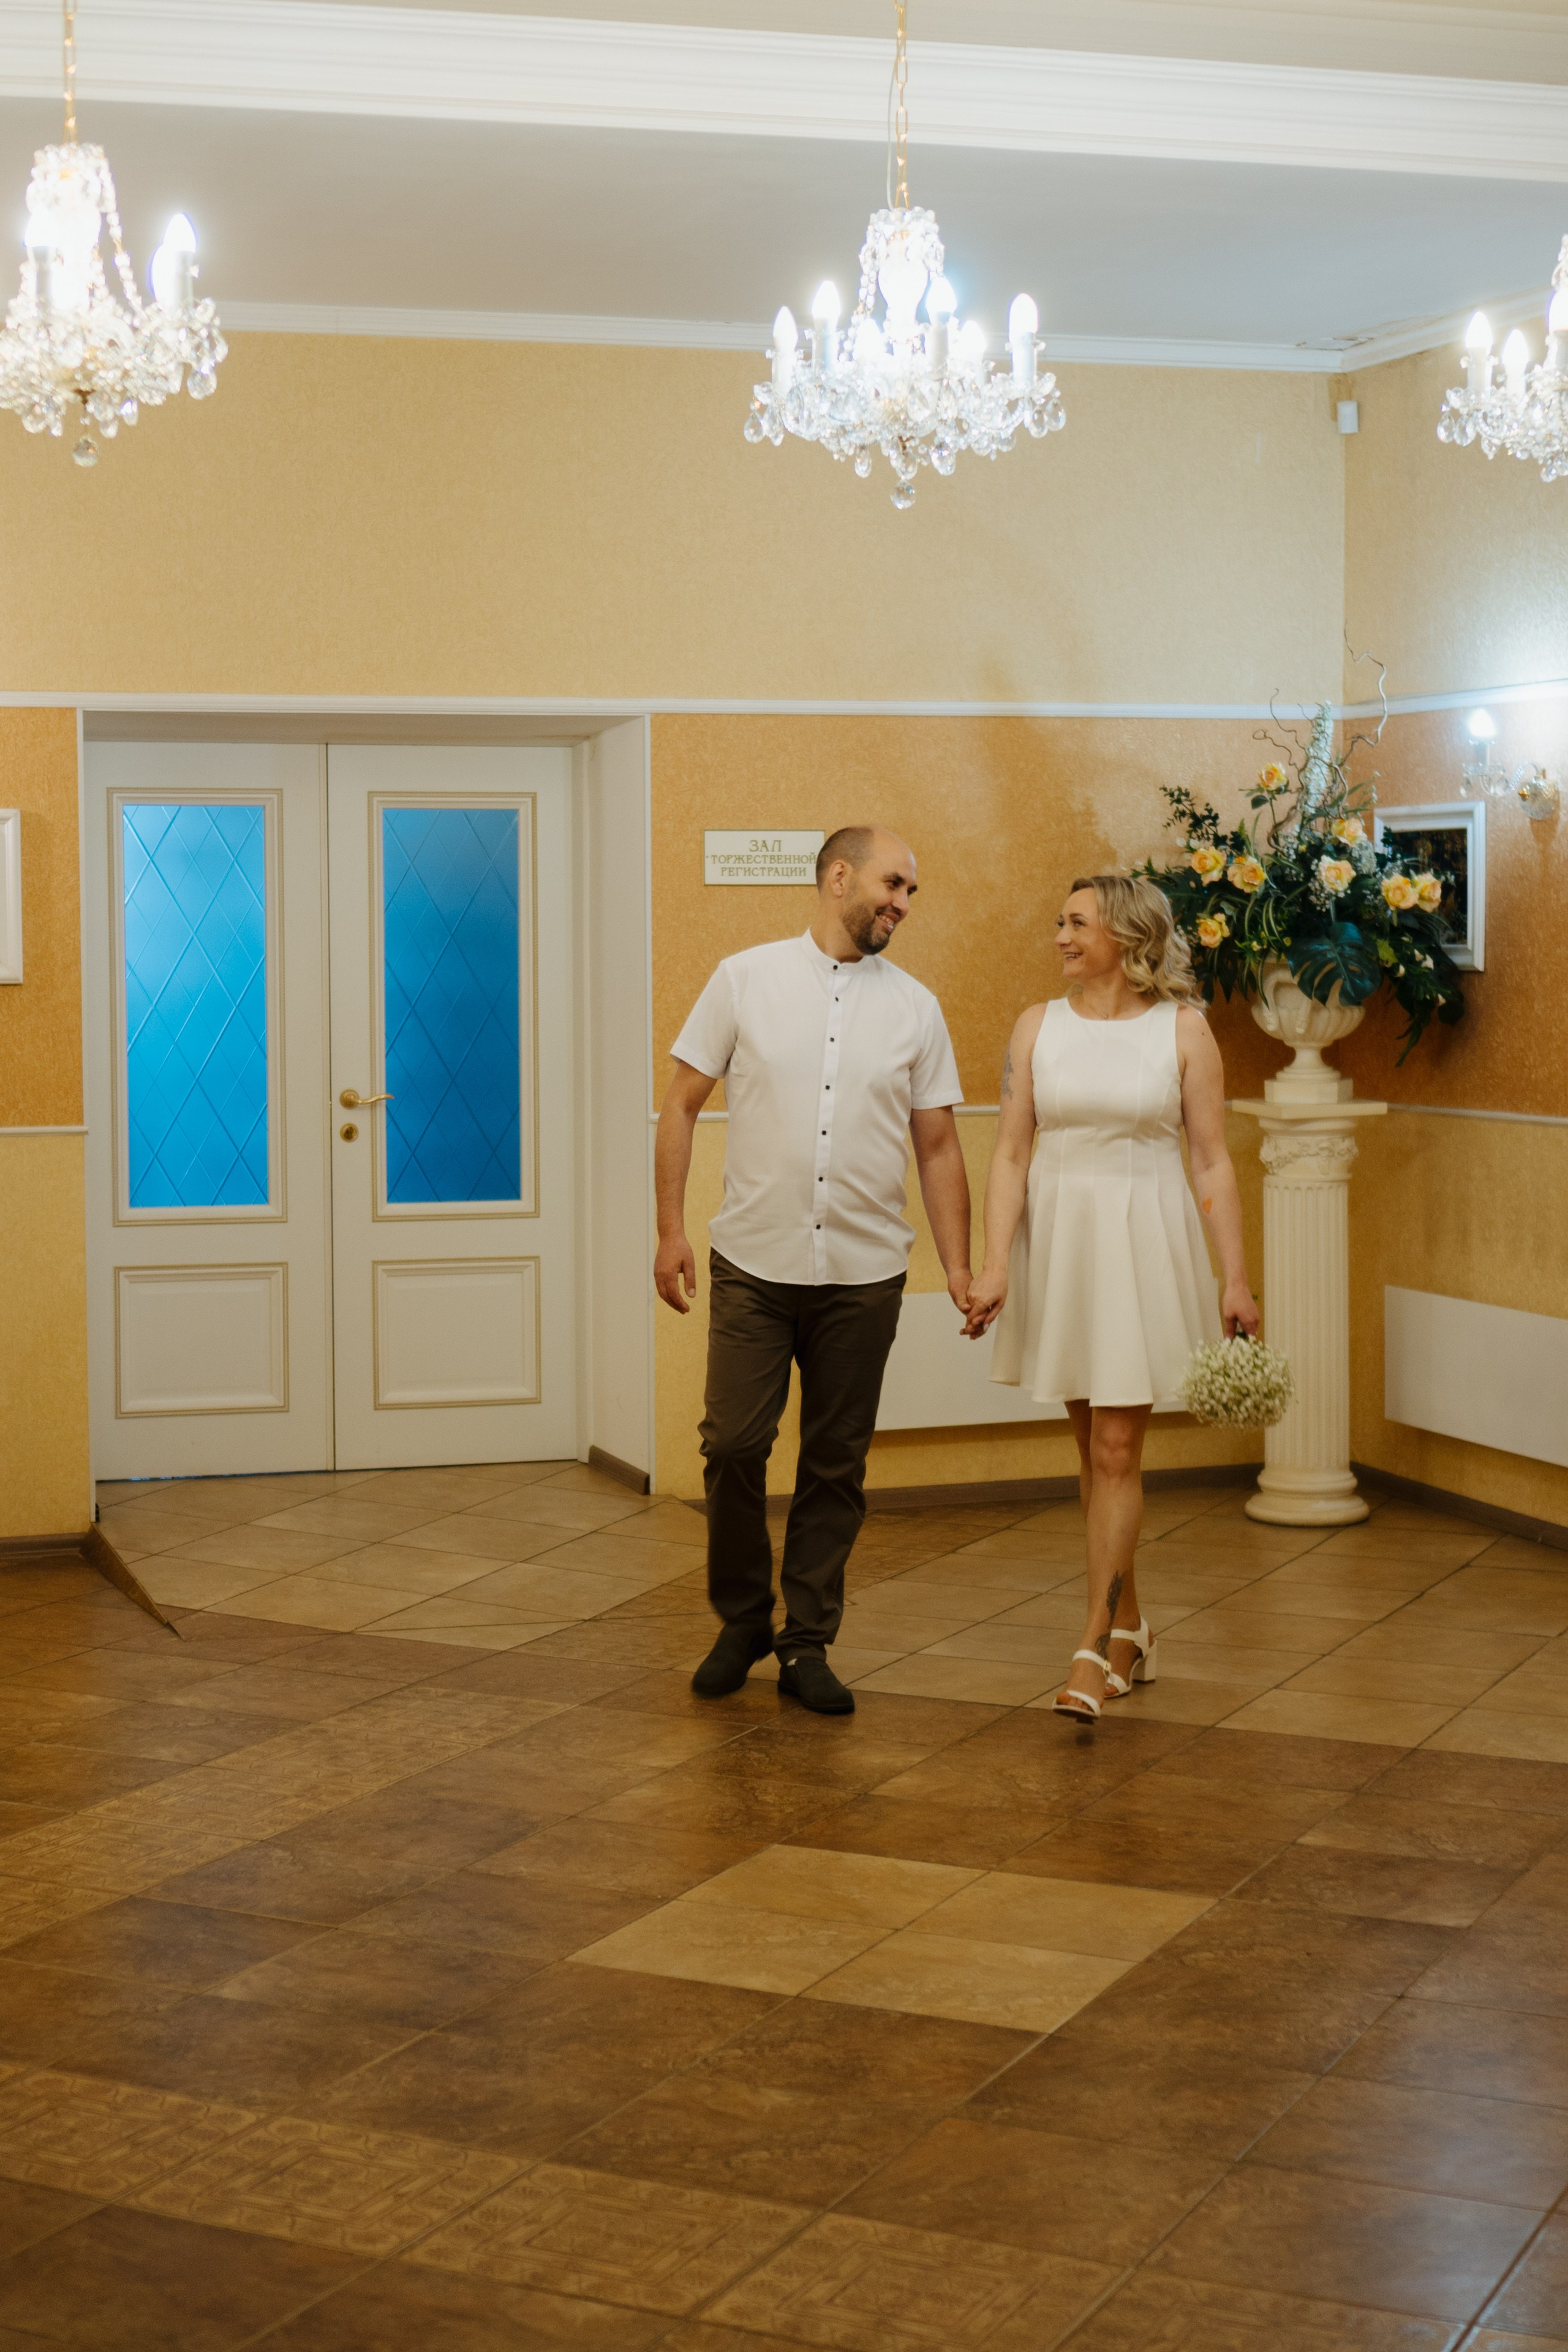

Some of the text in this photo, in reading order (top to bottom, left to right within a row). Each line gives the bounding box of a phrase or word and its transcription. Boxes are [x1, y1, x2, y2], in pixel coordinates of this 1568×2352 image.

[749, 840, 782, 852] ЗАЛ
[710, 853, 816, 864] ТОРЖЕСТВЕННОЙ
[720, 867, 807, 878] РЕГИСТРАЦИИ
